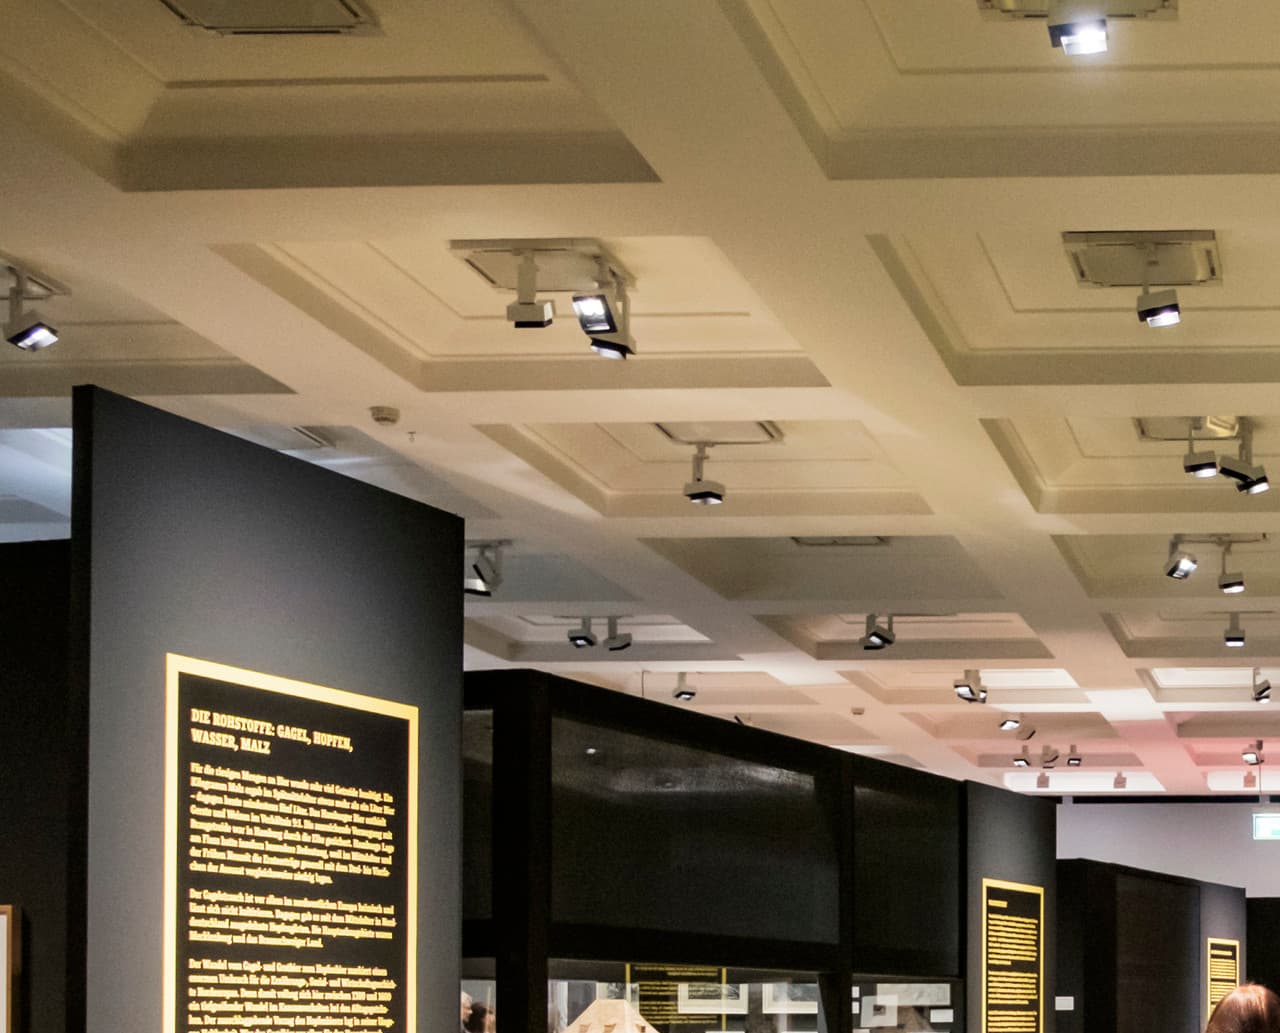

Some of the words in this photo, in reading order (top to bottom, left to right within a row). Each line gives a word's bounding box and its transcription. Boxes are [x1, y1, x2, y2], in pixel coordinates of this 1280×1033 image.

[190, 728, 239, 751] WASSER,
[240, 737, 270, 754] MALZ
[191, 708, 211, 724] DIE
[212, 713, 275, 736] ROHSTOFFE:
[277, 725, 311, 745] GAGEL,
